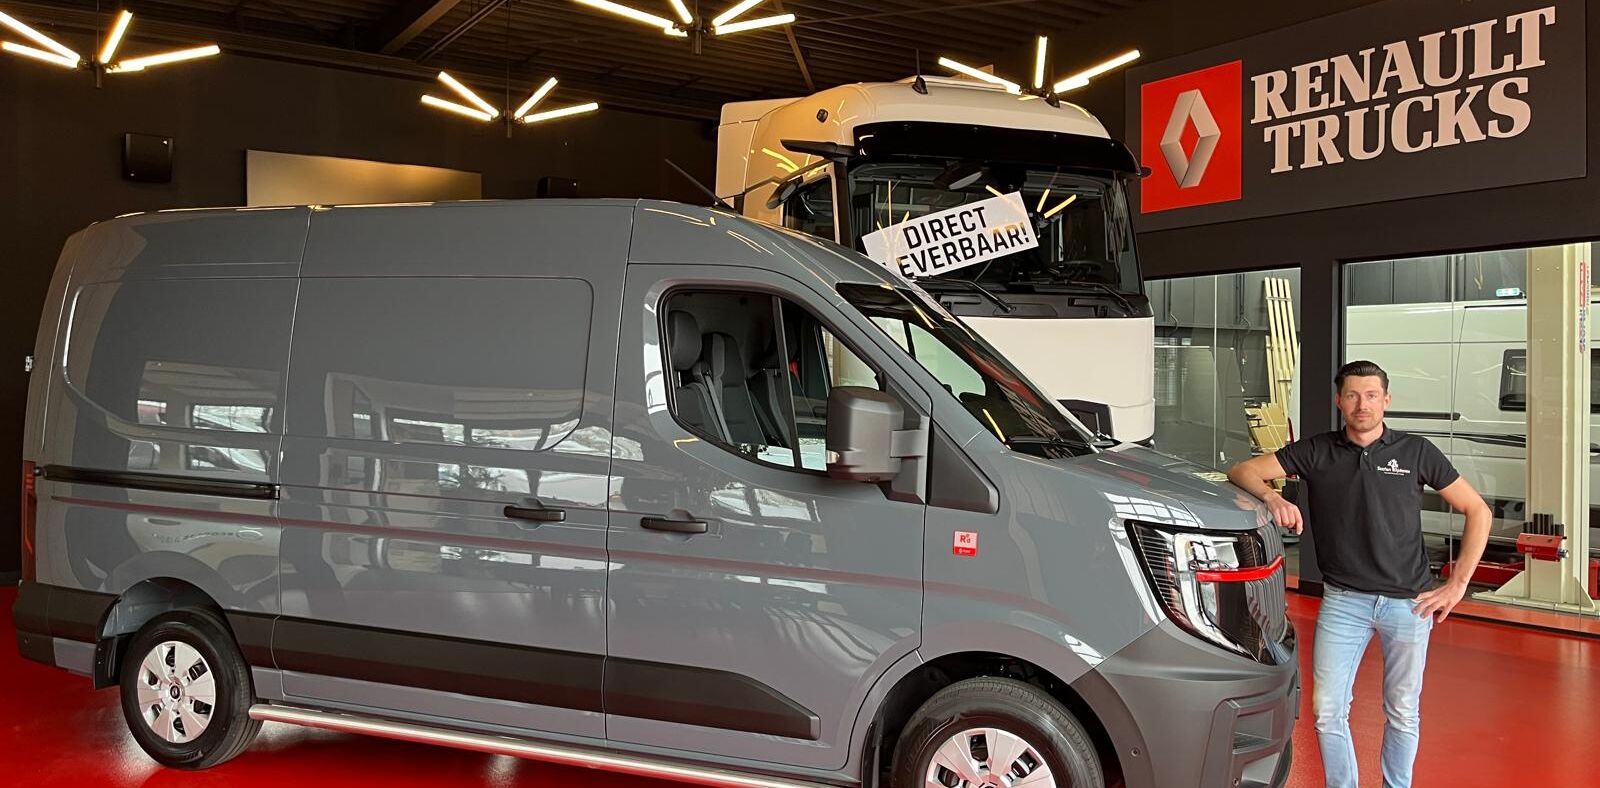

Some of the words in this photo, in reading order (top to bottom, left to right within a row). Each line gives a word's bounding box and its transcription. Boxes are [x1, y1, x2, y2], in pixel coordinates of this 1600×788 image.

[1250, 6, 1556, 125] RENAULT
[1263, 77, 1532, 174] TRUCKS
[882, 221, 1030, 278] EVERBAAR!
[902, 206, 988, 250] DIRECT
